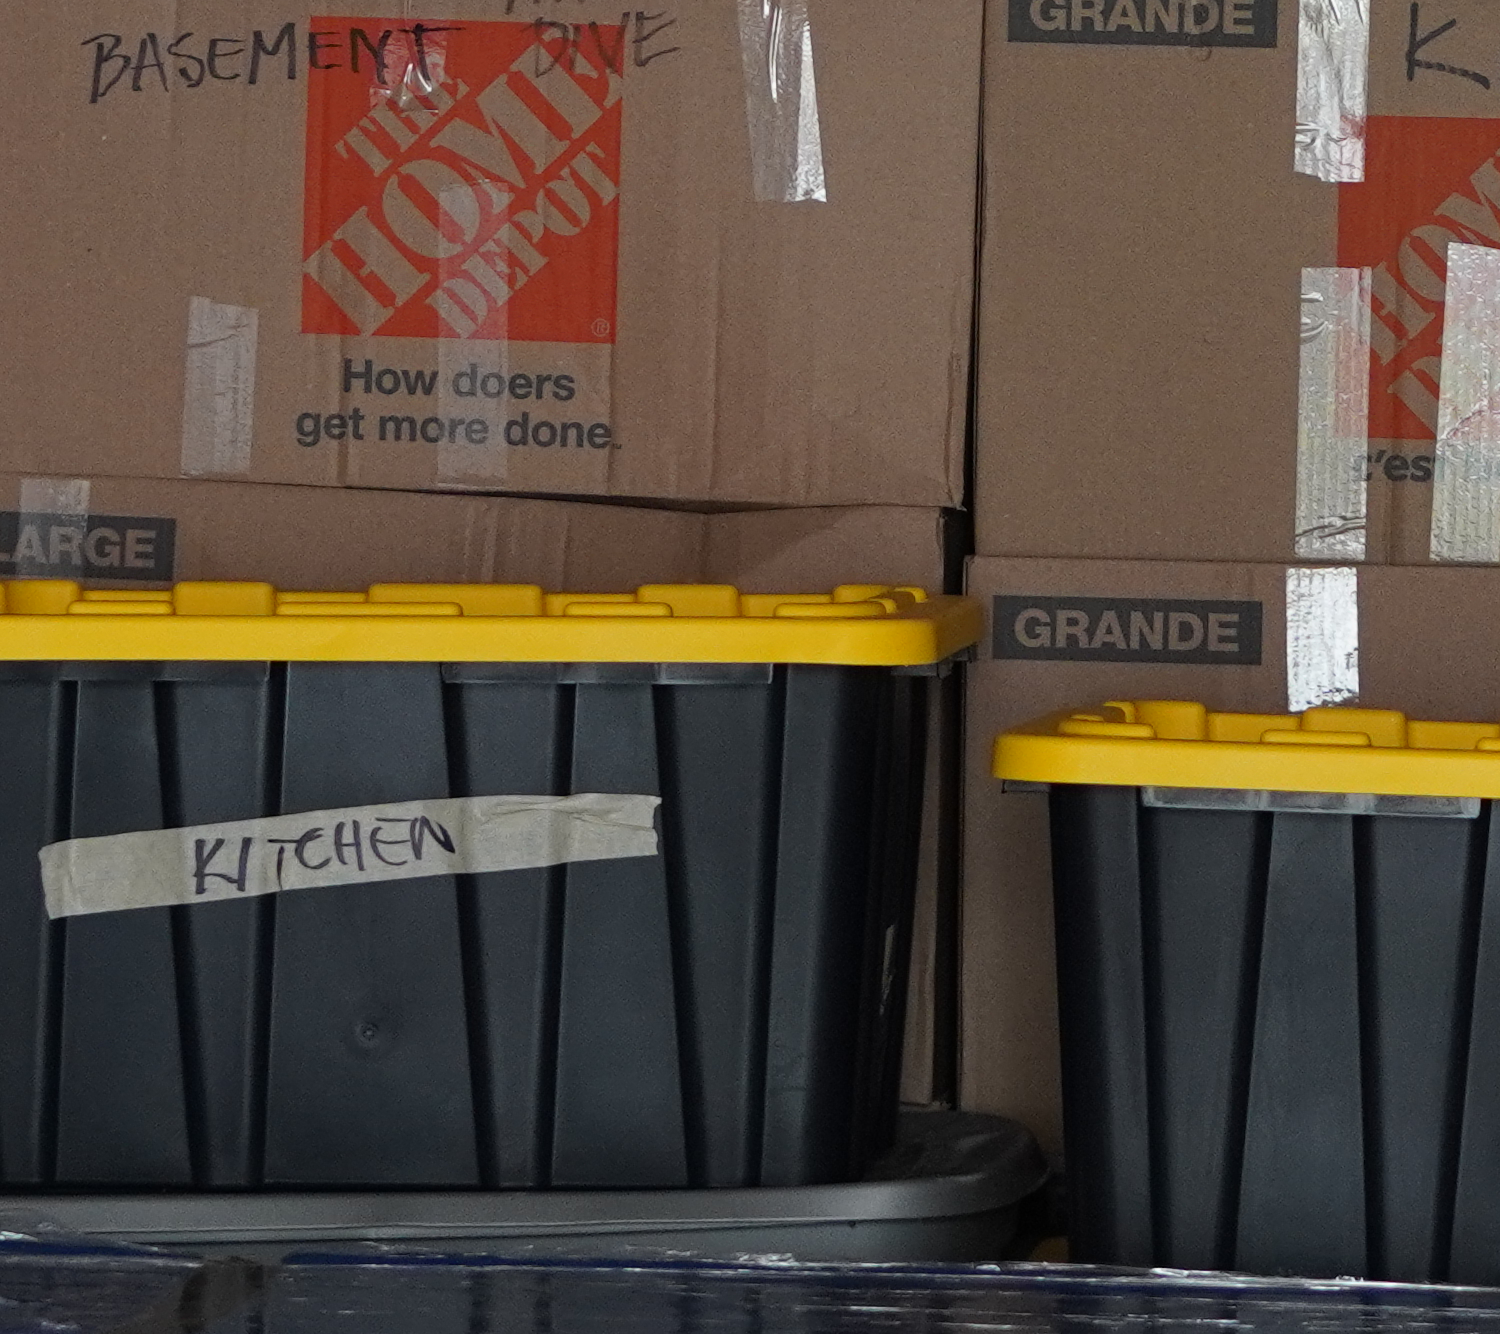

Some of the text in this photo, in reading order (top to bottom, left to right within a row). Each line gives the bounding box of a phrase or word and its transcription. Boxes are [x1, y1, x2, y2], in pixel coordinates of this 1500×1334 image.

[81, 21, 465, 104] BASEMENT
[301, 27, 625, 335] HOME
[425, 142, 620, 339] DEPOT
[342, 357, 576, 401] How doers
[296, 407, 365, 447] get
[378, 414, 489, 445] more
[1014, 608, 1240, 652] GRANDE
[191, 814, 456, 893] KITCHEN
